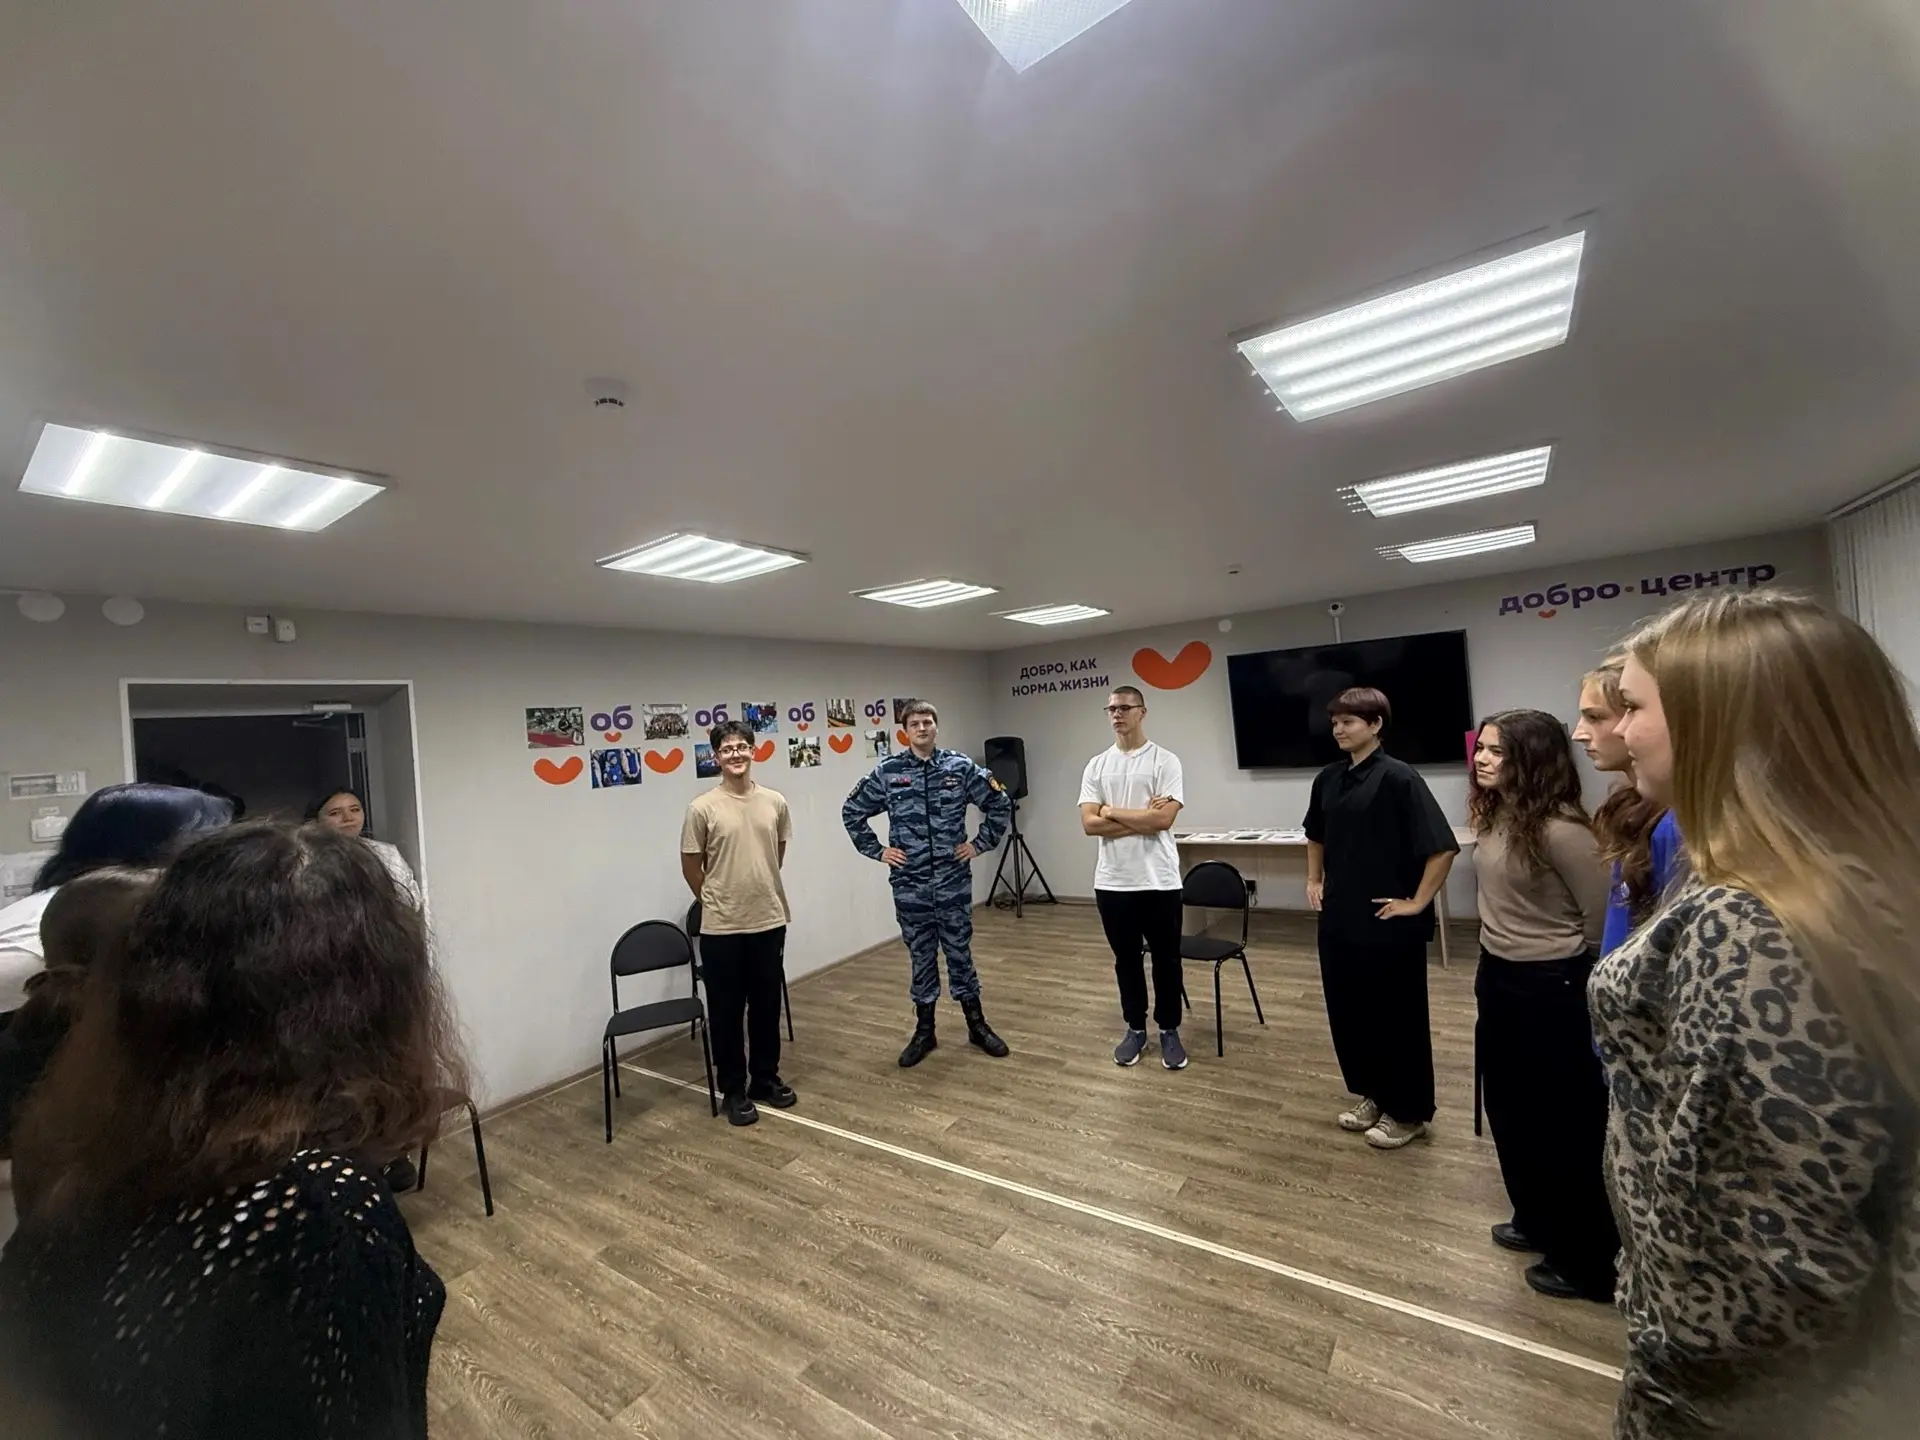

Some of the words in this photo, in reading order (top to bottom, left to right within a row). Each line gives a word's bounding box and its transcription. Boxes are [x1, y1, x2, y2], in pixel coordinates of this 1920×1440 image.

[1020, 662, 1068, 680] ДОБРО,
[1070, 658, 1097, 672] КАК
[1012, 681, 1057, 697] НОРМА
[1059, 675, 1109, 692] ЖИЗНИ
[590, 705, 634, 732] об
[788, 702, 816, 723] об
